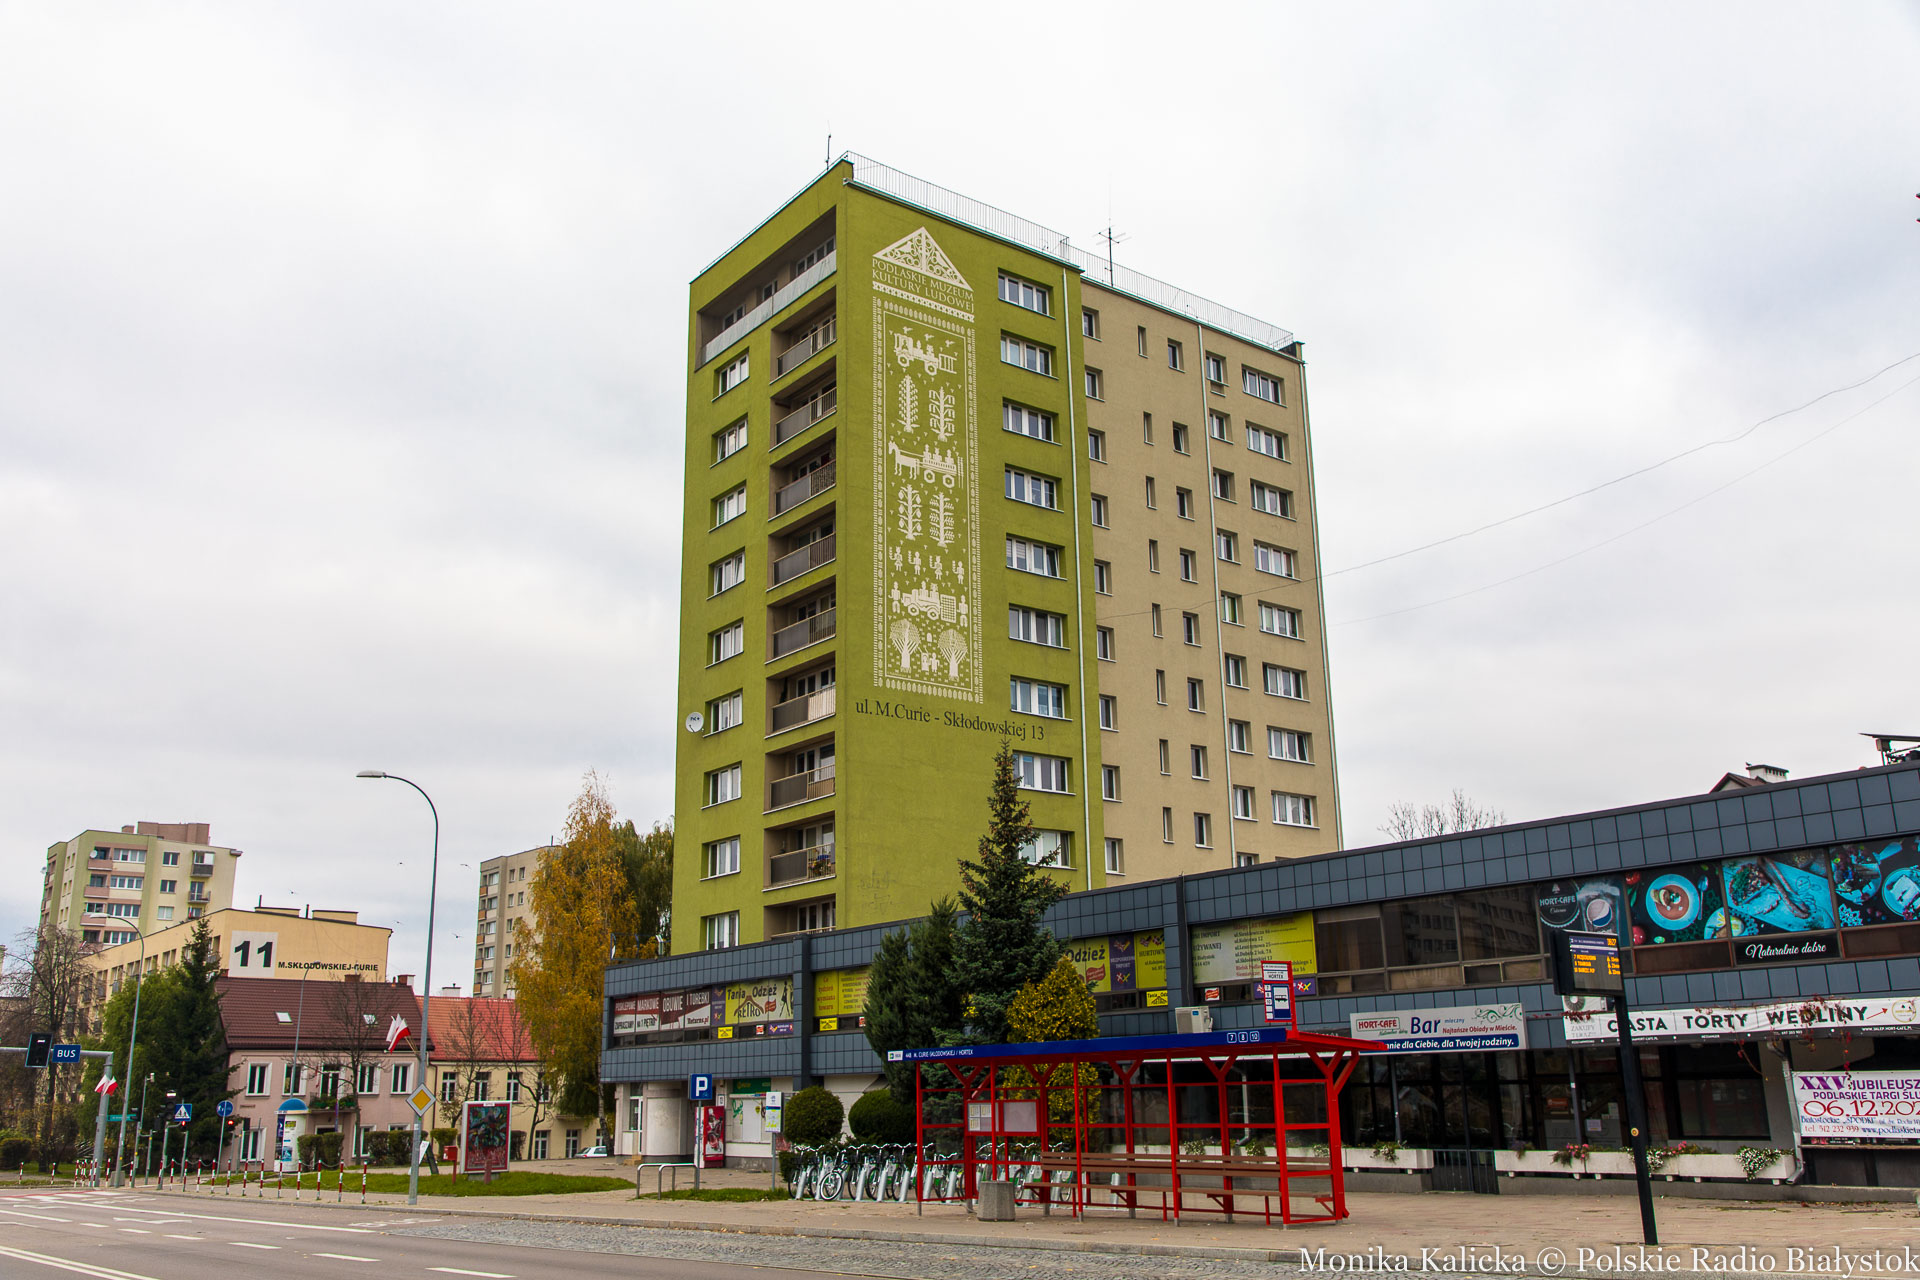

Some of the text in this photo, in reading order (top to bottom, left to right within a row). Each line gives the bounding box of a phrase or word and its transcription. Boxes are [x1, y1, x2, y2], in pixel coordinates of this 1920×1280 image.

[872, 258, 974, 302] PODLASKIE MUZEUM
[872, 268, 974, 313] KULTURY LUDOWEJ
[855, 698, 872, 715] ul.
[943, 710, 1027, 742] Skłodowskiej
[1031, 725, 1045, 741] 13
[233, 940, 274, 968] 11
[1066, 944, 1106, 963] Odzież
[1745, 941, 1827, 959] Naturalnie dobre
[727, 983, 777, 1000] Tania Odzież
[637, 997, 659, 1011] MARKOWE
[662, 995, 683, 1012] OBUWIE
[1410, 1016, 1441, 1035] Bar
[1442, 1025, 1469, 1035] Najtańsze
[1469, 1024, 1489, 1033] Obiady
[1495, 1023, 1518, 1032] Mieście.
[1607, 1017, 1668, 1033] CASTA
[1683, 1013, 1748, 1030] TORTY
[1401, 1041, 1413, 1049] dla
[1415, 1039, 1440, 1049] Ciebie,
[1442, 1039, 1454, 1048] dla
[1455, 1038, 1481, 1049] Twojej
[1482, 1037, 1514, 1048] rodziny.
[57, 1049, 76, 1058] BUS
[696, 1076, 708, 1097] P
[1798, 1075, 1848, 1090] XXV
[1813, 1091, 1868, 1100] PODLASKIE
[1868, 1091, 1899, 1099] TARGI
